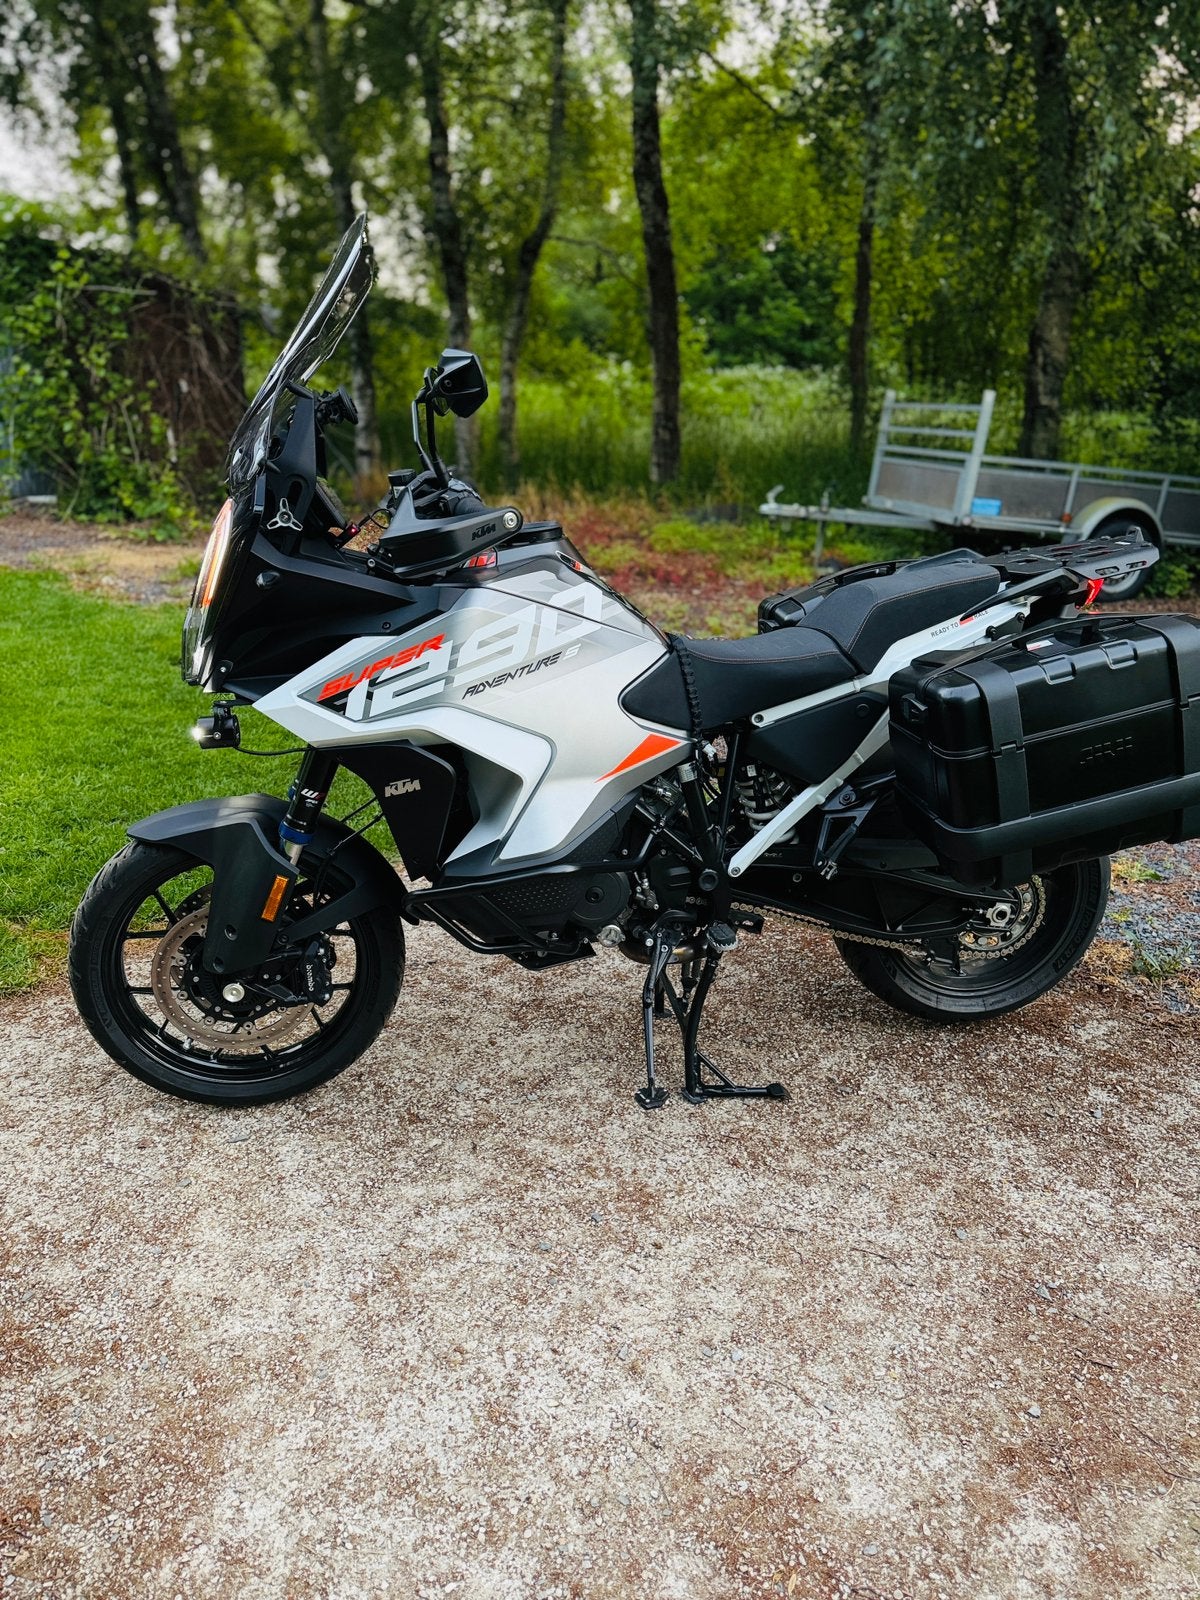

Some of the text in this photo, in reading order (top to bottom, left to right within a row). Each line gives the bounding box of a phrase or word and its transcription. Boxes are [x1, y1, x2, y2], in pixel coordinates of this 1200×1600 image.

[472, 523, 496, 541] KTM
[930, 626, 950, 637] READY
[345, 582, 602, 721] 1290
[317, 633, 446, 701] SUPER
[462, 642, 582, 700] ADVENTURE S
[384, 778, 421, 797] KTM
[306, 964, 315, 991] brembo
